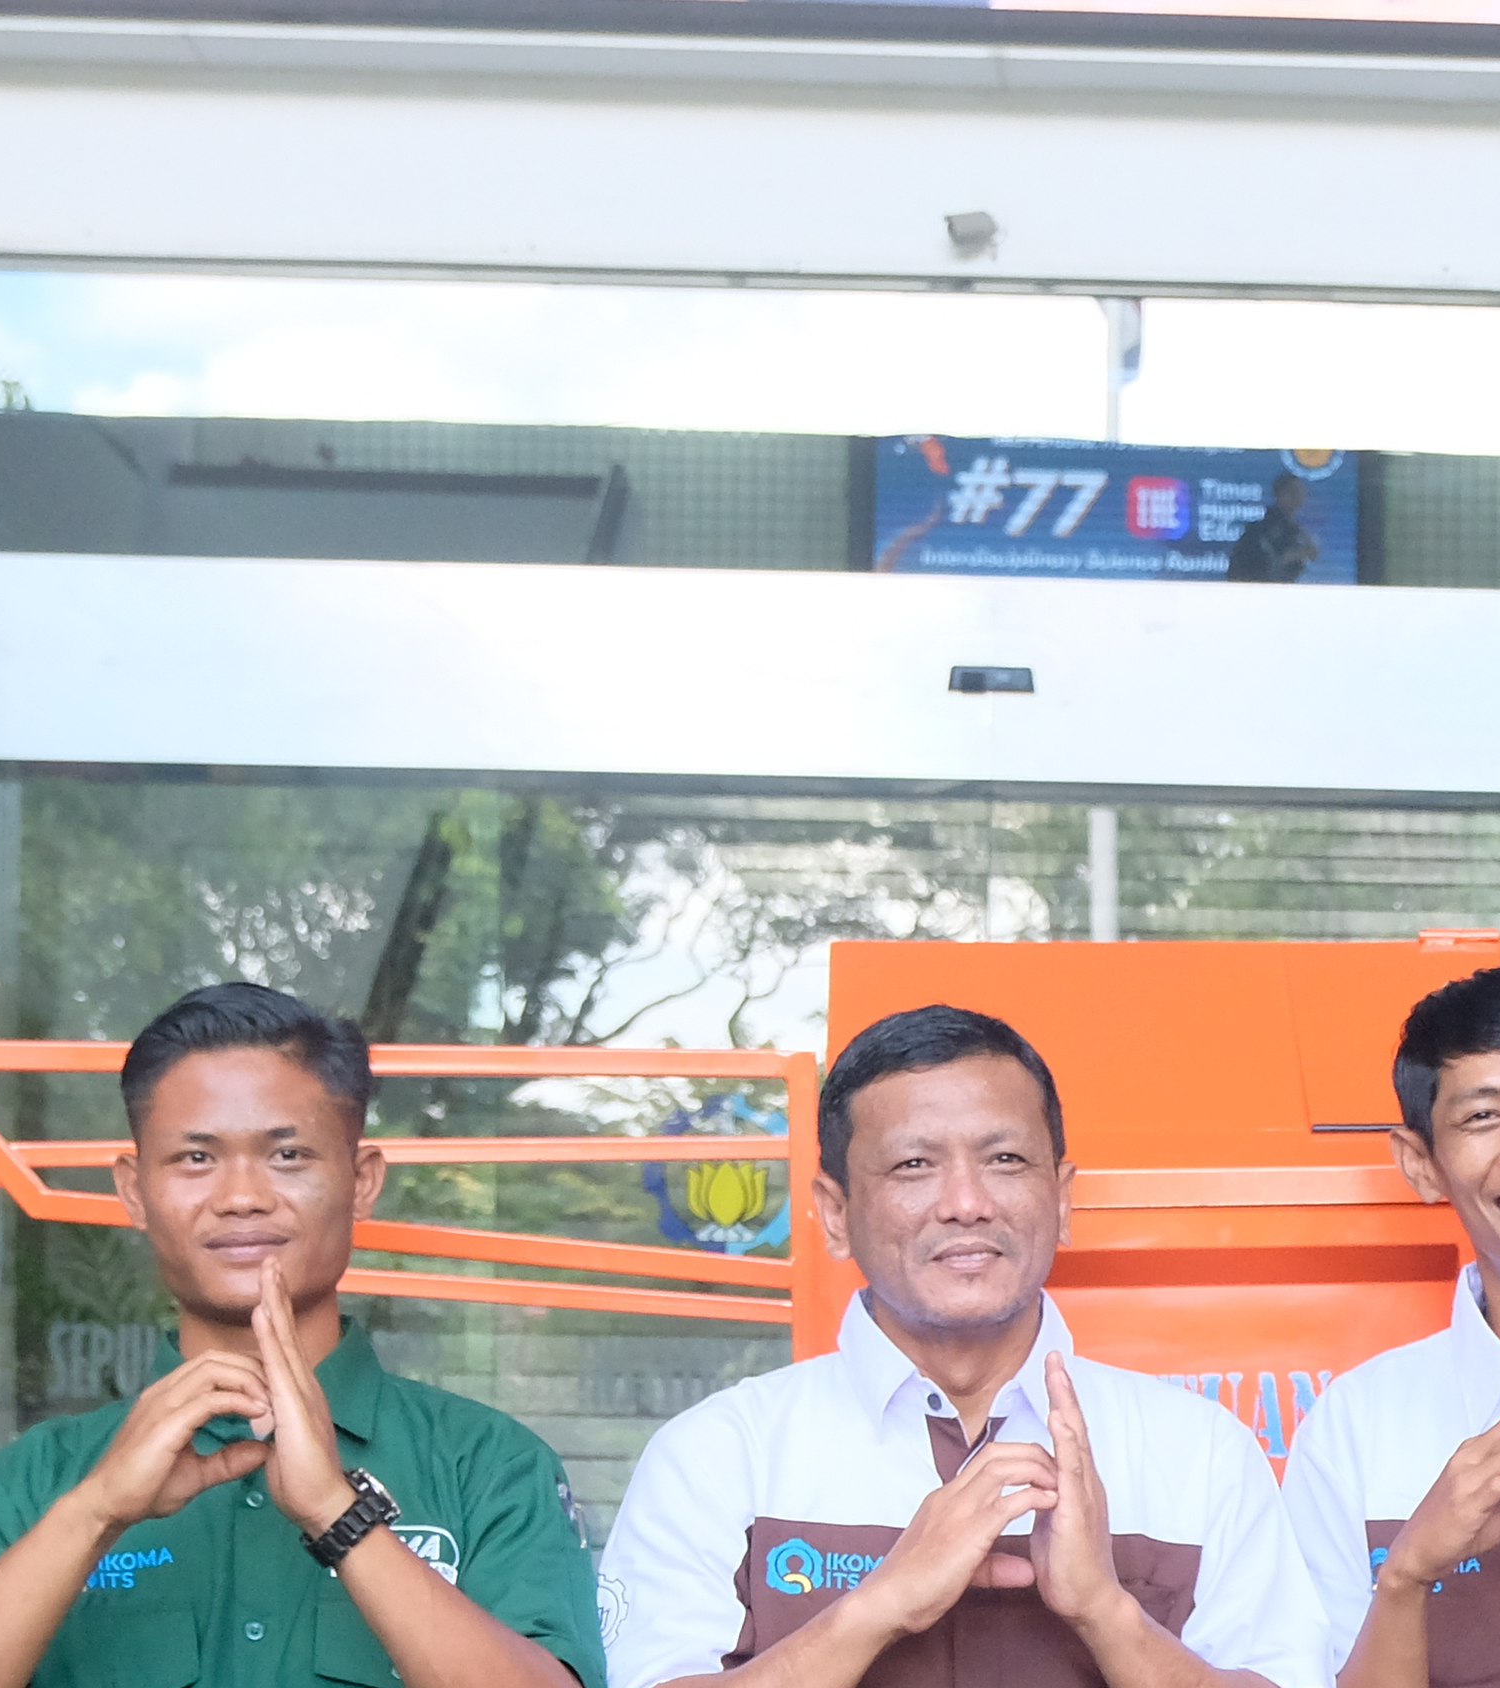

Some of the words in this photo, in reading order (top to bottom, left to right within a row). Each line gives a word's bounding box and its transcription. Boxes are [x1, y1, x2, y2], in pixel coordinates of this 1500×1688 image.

[948, 455, 1108, 538] #77
[98, 1546, 174, 1571] IKOMA
[825, 1552, 885, 1573] IKOM
[100, 1571, 135, 1589] ITS
[825, 1570, 860, 1591] ITS
